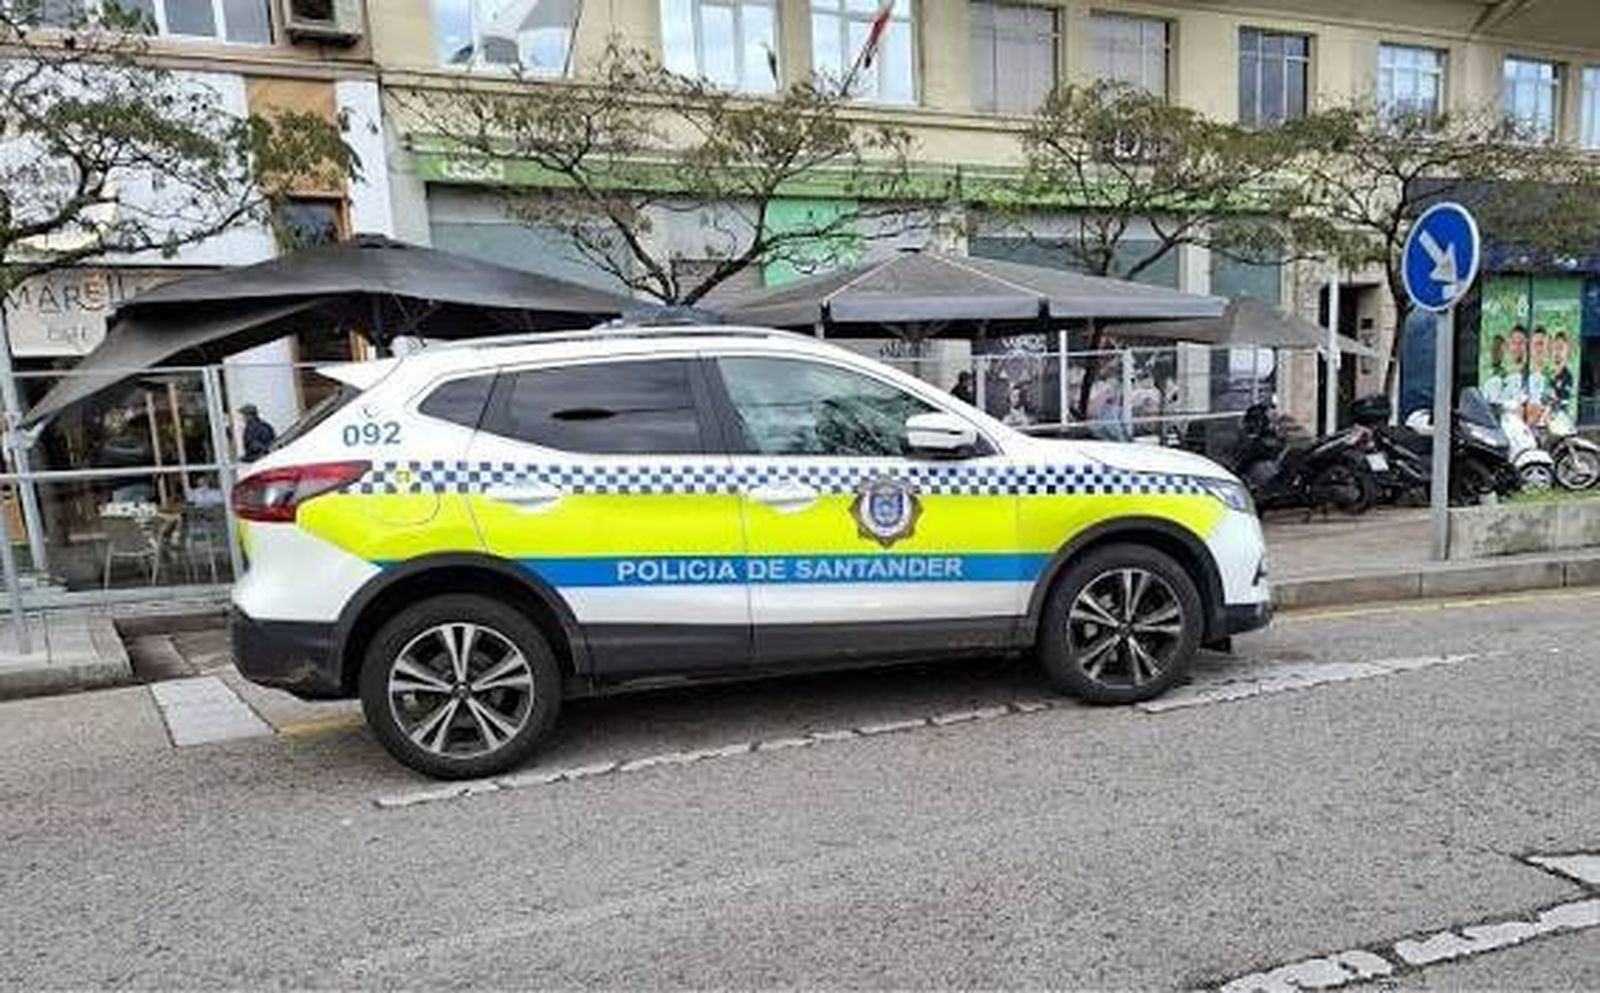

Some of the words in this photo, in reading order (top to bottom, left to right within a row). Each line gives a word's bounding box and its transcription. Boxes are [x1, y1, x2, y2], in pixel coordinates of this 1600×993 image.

[343, 421, 401, 447] 092
[617, 560, 737, 581] POLICIA
[748, 559, 786, 579] DE
[796, 557, 963, 578] SANTANDER
